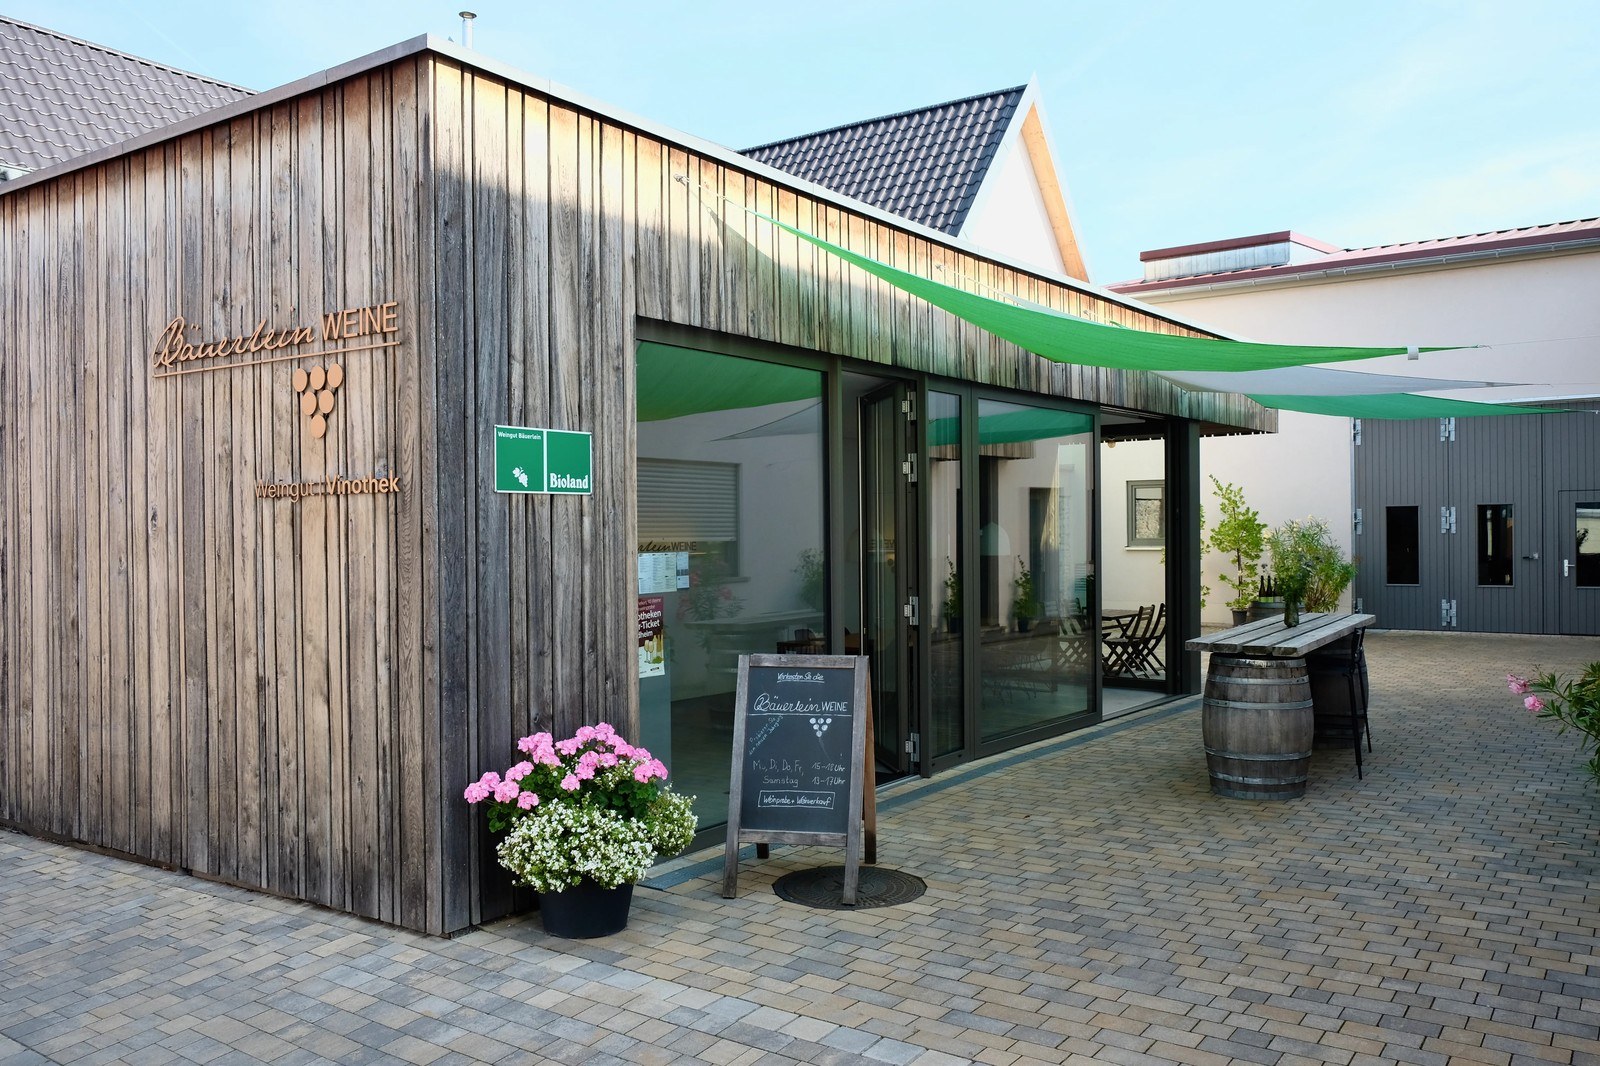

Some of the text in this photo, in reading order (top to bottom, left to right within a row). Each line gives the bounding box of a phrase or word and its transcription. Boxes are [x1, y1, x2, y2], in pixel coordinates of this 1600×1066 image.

[153, 301, 399, 368] Bäuerlein WEINE
[498, 431, 518, 440] Weingut
[253, 478, 315, 503] Weingut
[325, 470, 400, 495] Vinothek
[549, 473, 589, 489] Bioland
[671, 541, 697, 551] WEINE
[753, 692, 848, 713] Bäuerlein WEINE
[762, 776, 799, 788] Samstag
